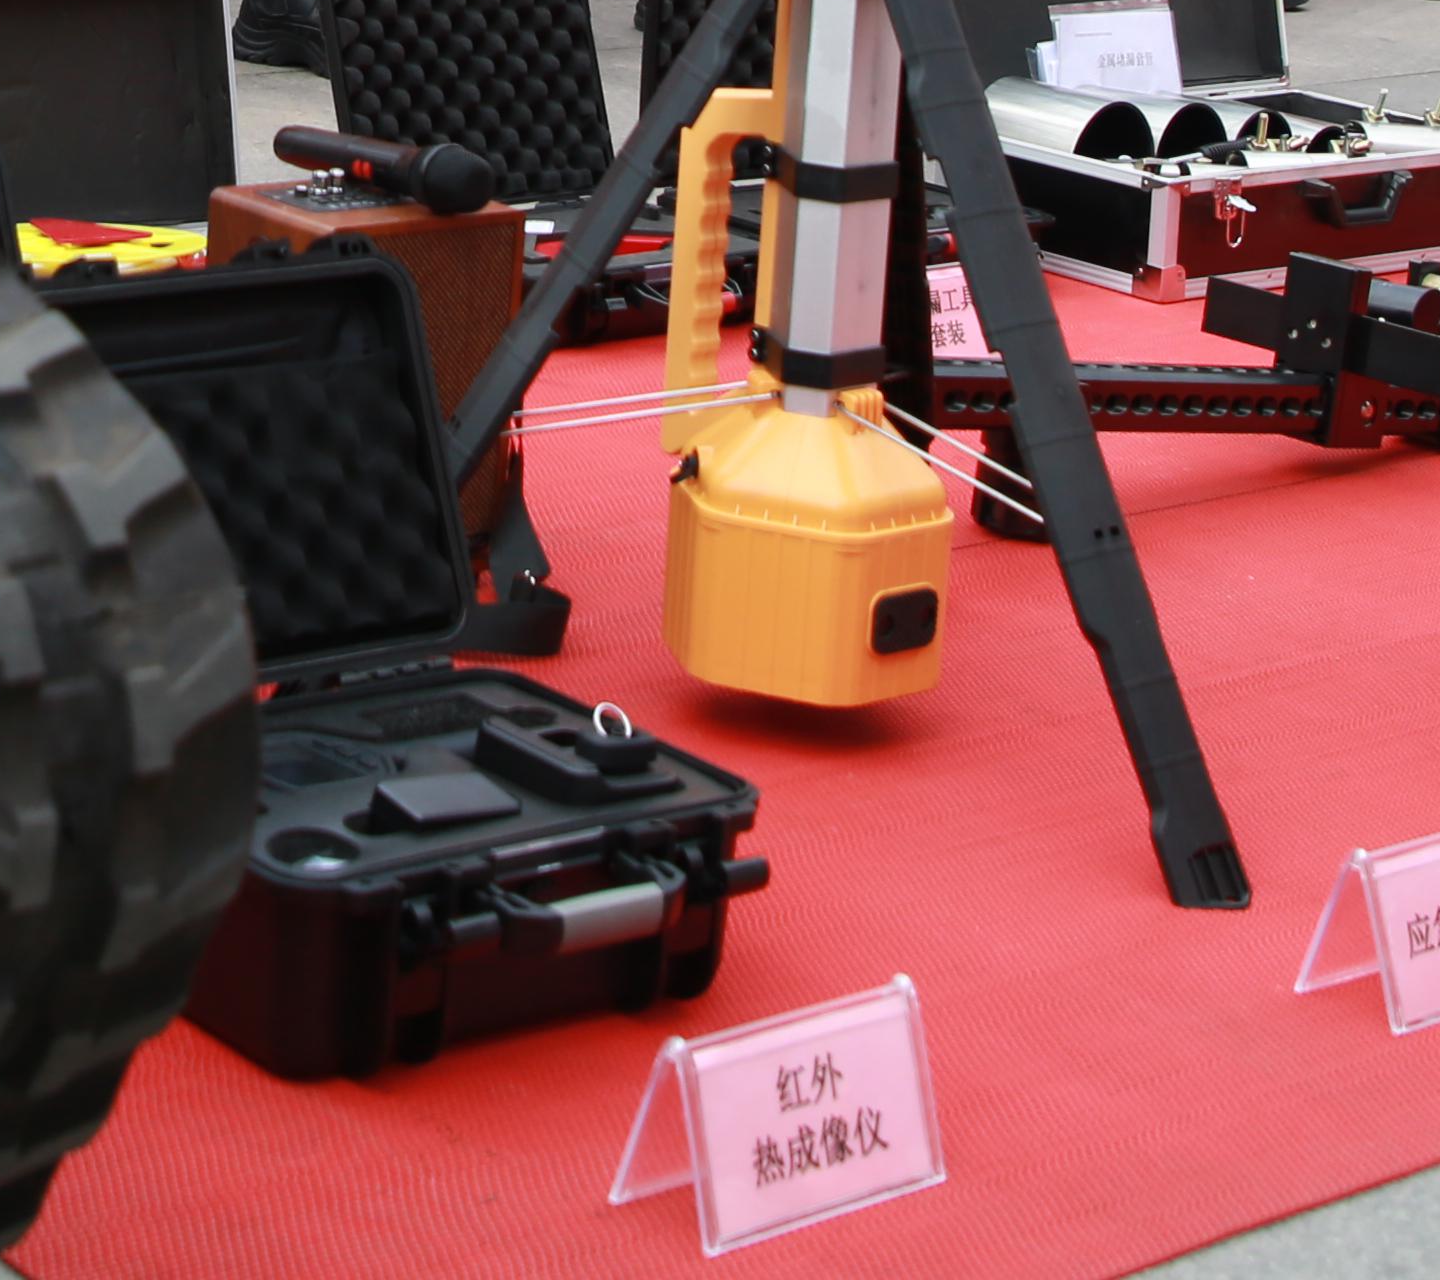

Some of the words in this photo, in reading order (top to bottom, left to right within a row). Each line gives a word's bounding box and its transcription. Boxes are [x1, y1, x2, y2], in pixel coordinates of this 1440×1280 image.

[775, 1052, 843, 1113] 红外
[751, 1107, 890, 1189] 热成像仪
